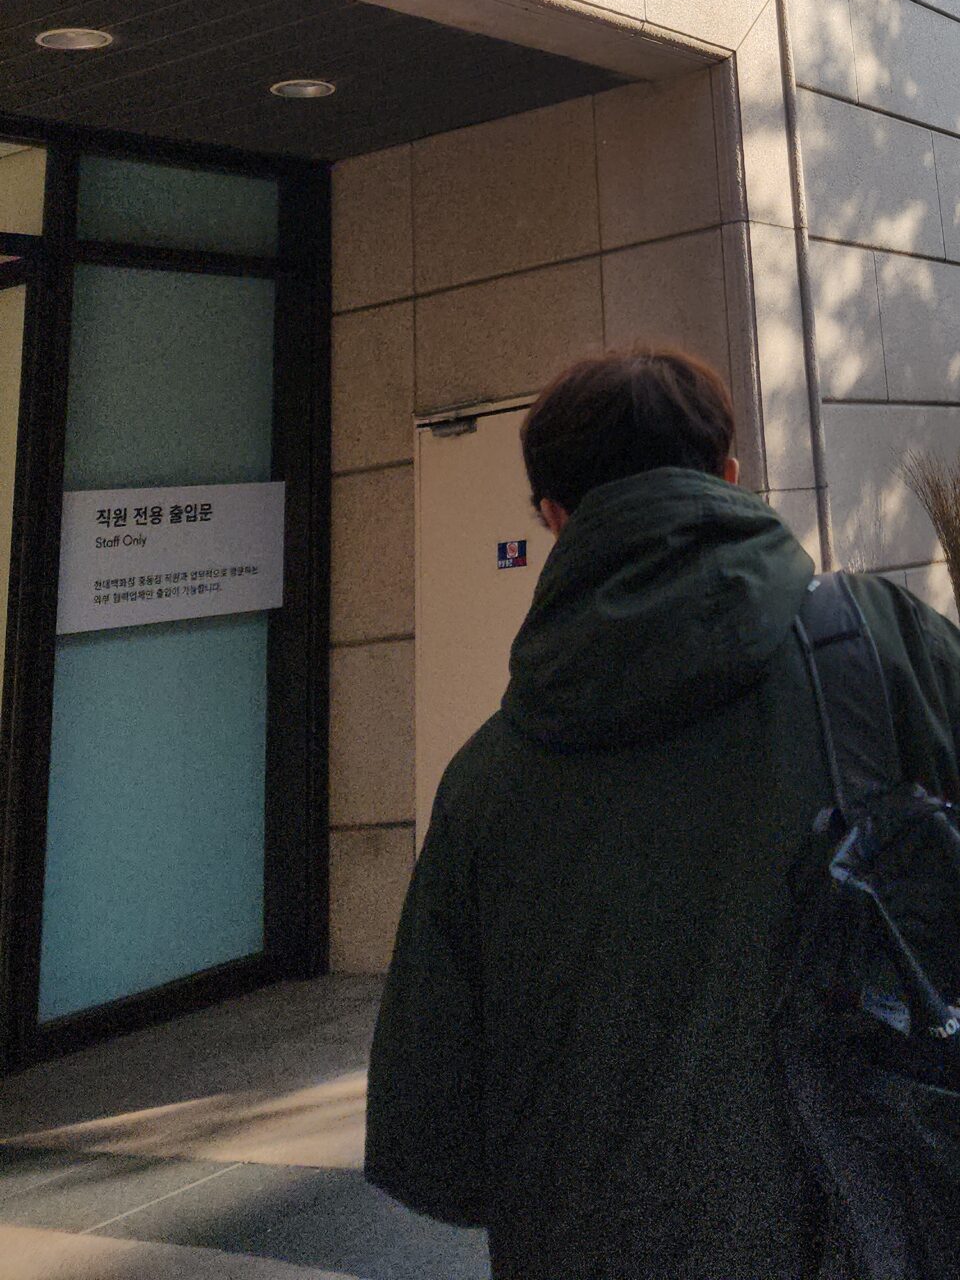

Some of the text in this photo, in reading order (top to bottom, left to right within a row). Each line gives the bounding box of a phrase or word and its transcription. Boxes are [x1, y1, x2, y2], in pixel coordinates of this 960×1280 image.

[96, 503, 213, 527] 직원 전용 출입문
[96, 533, 147, 548] Staff Only
